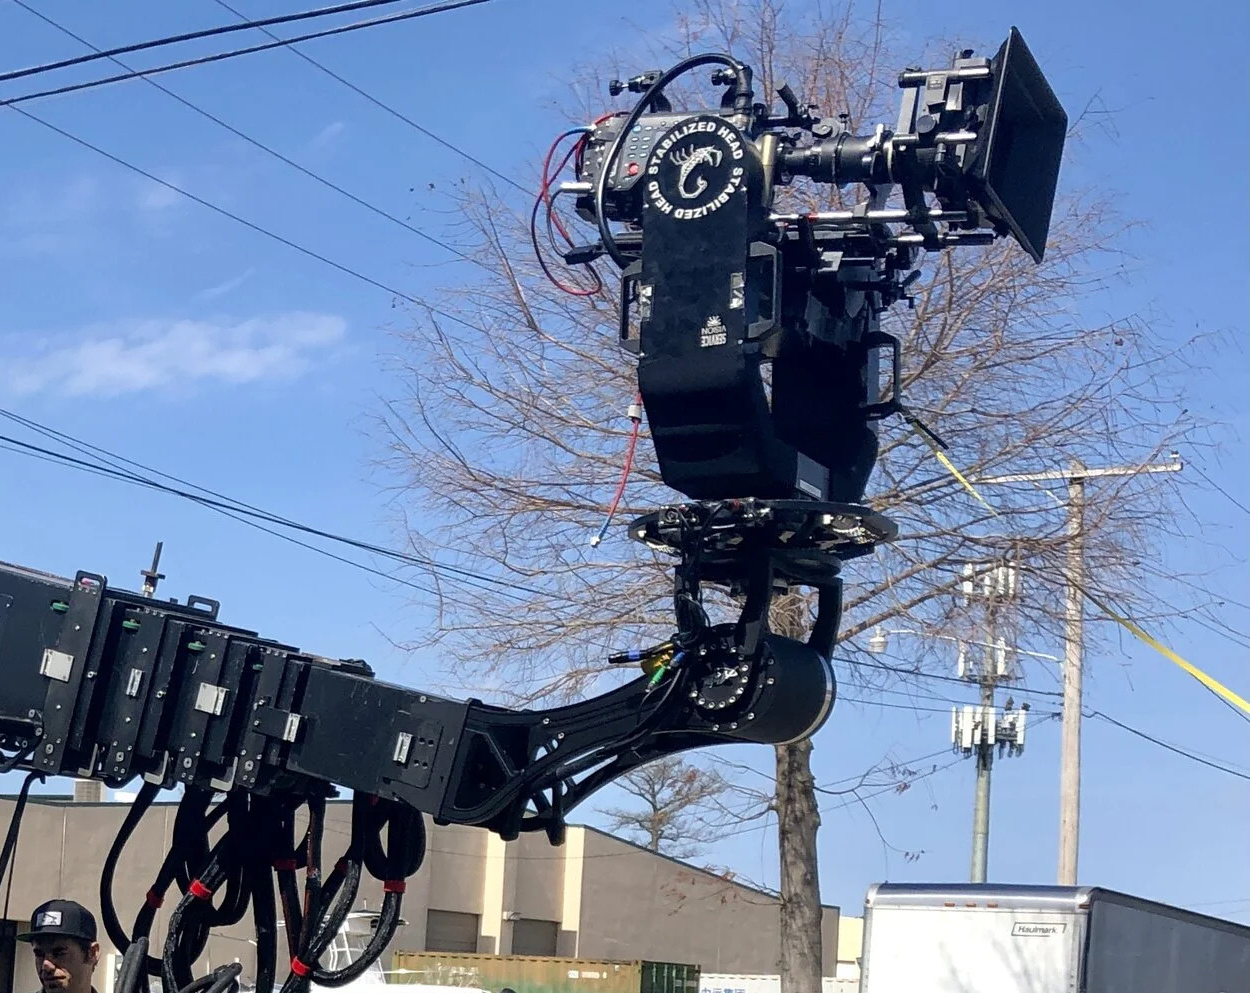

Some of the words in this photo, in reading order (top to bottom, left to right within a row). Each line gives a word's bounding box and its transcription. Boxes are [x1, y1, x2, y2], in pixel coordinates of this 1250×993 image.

[649, 122, 716, 175] STABILIZED
[717, 126, 744, 160] HEAD
[649, 181, 674, 215] HEAD
[674, 167, 744, 219] STABILIZED
[700, 333, 727, 348] SERVICE
[701, 324, 727, 335] VISION
[1018, 925, 1058, 934] Haulmark
